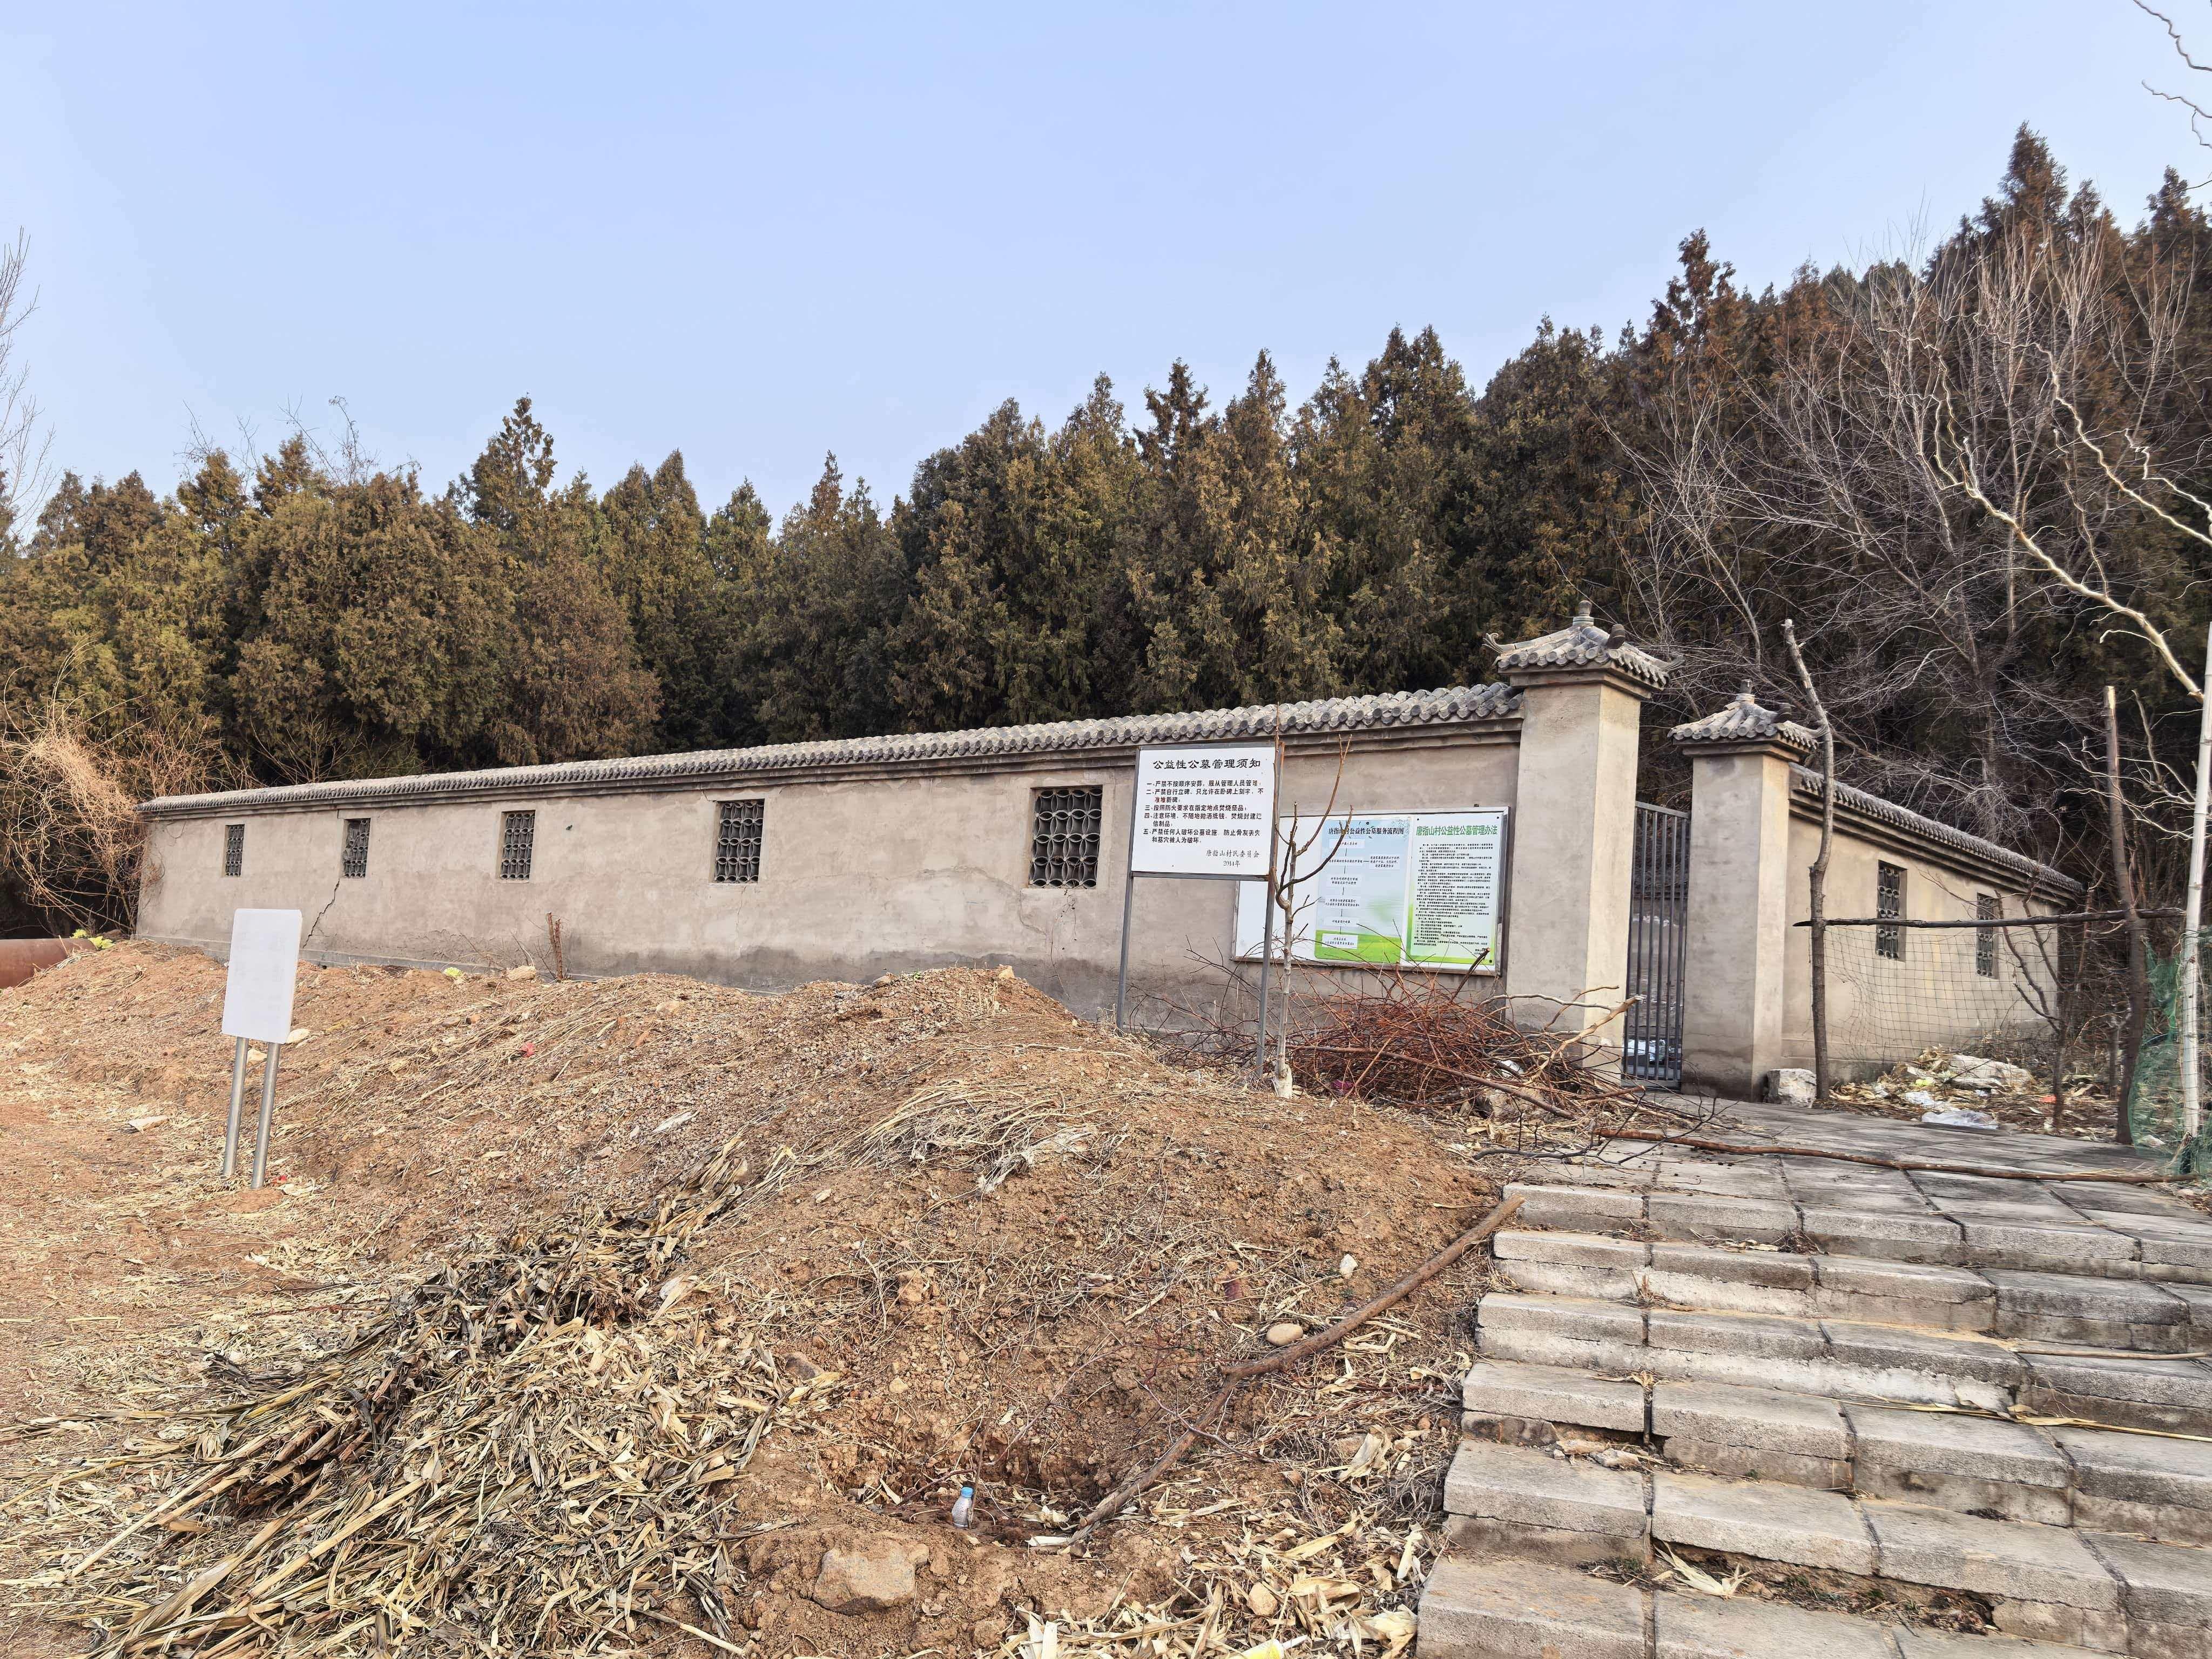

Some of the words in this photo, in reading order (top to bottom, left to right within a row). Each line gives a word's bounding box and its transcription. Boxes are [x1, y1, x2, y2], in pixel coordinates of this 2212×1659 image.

[1153, 758, 1260, 770] 公益性公墓管理须知
[1328, 827, 1404, 835] 唐指公益性公墓服务流程图
[1416, 825, 1498, 836] 唐指山村公益性公墓管理办法
[1206, 849, 1260, 858] 唐指山村民委员会
